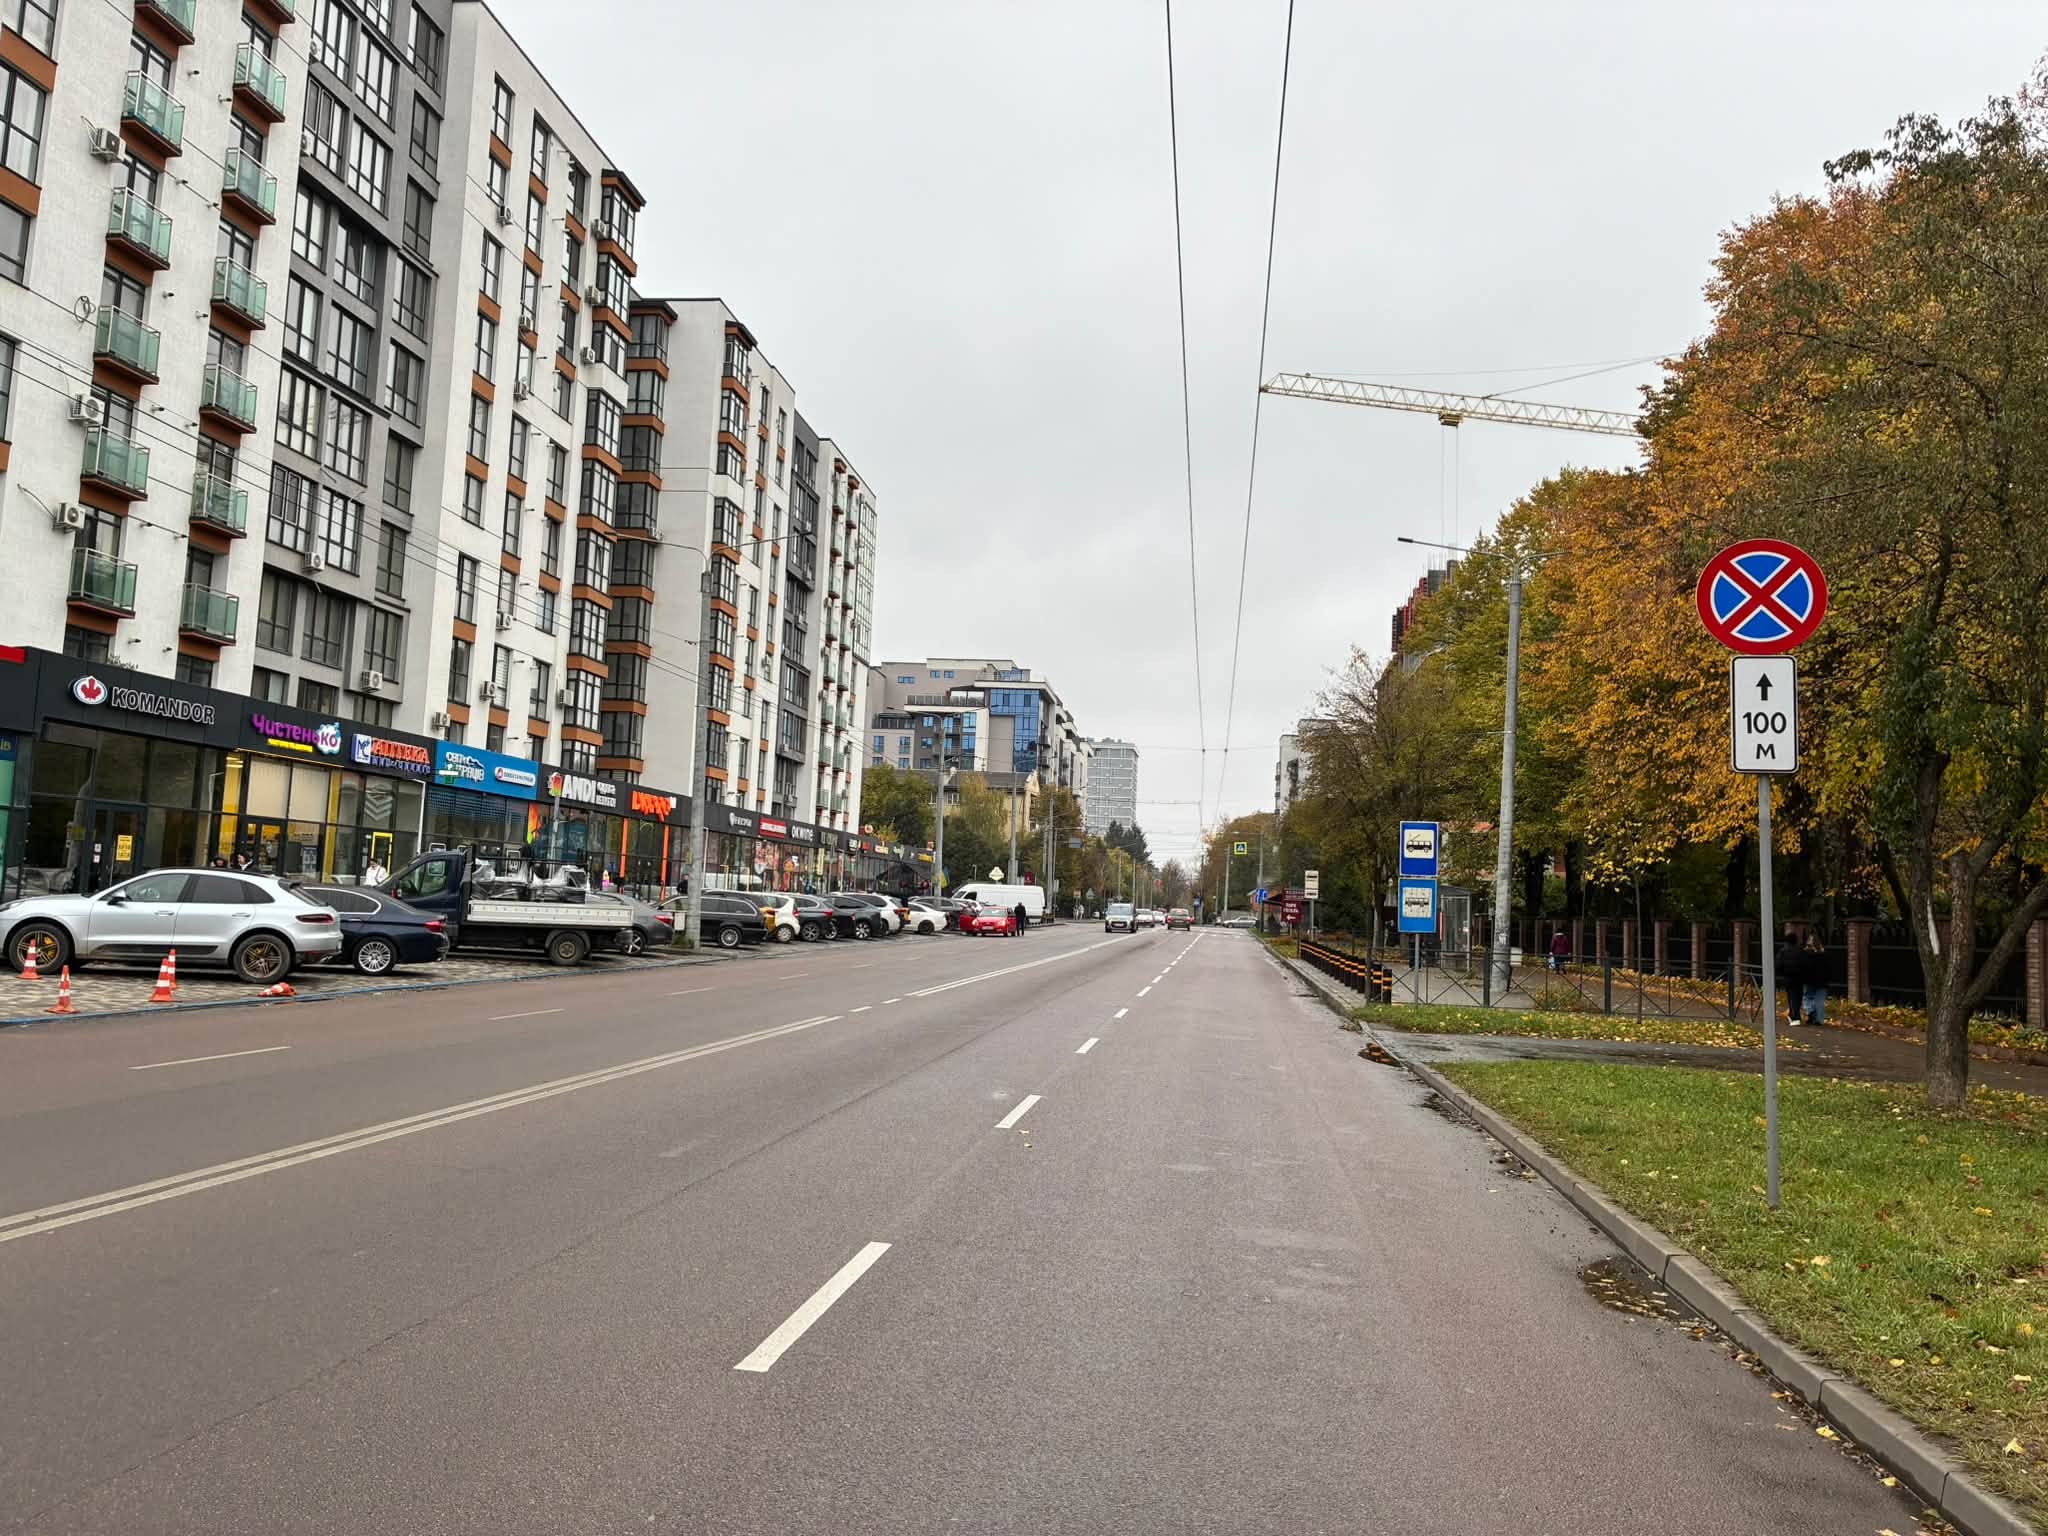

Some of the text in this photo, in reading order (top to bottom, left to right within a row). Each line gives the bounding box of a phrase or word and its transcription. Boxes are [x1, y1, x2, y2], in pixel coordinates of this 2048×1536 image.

[111, 686, 216, 724] KOMANDOR
[1742, 711, 1787, 734] 100
[252, 713, 338, 748] Чистенько
